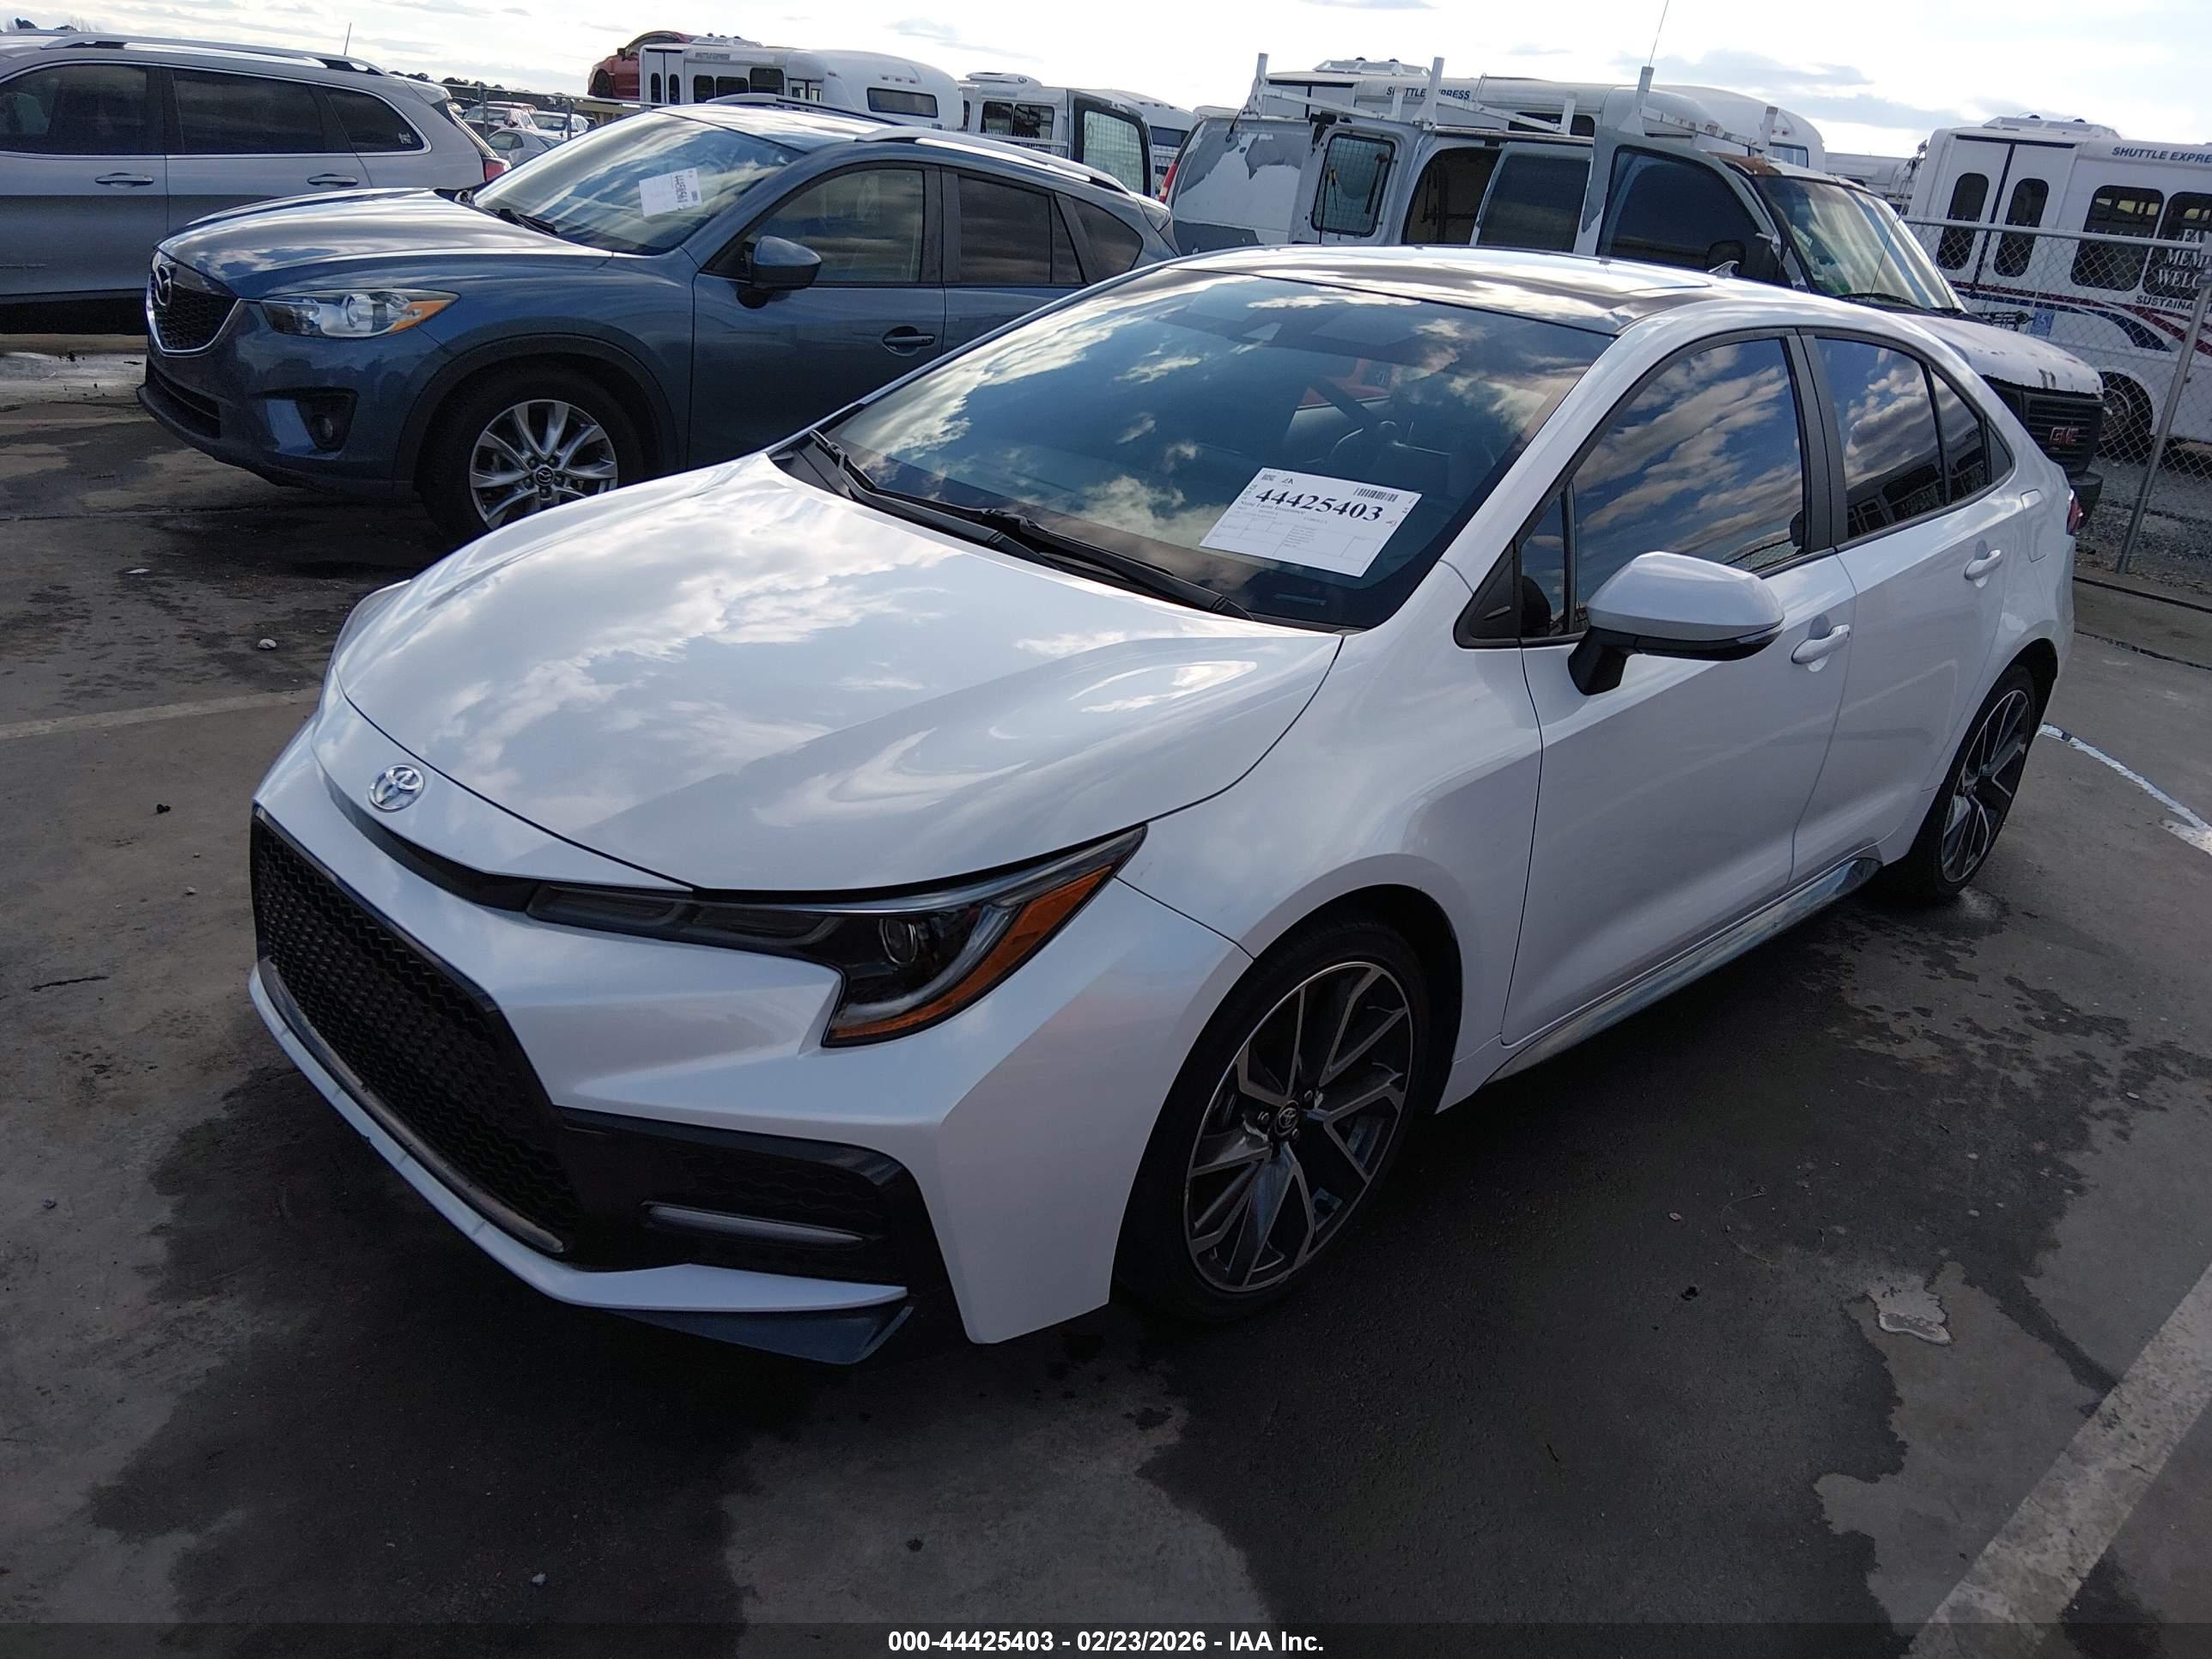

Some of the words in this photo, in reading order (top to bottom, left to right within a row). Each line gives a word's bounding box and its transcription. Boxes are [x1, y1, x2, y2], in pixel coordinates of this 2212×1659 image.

[1387, 86, 1427, 98] STTLE
[1438, 88, 1471, 101] PRESS
[2112, 146, 2169, 161] SHUTTLE
[1255, 489, 1383, 522] 44425403
